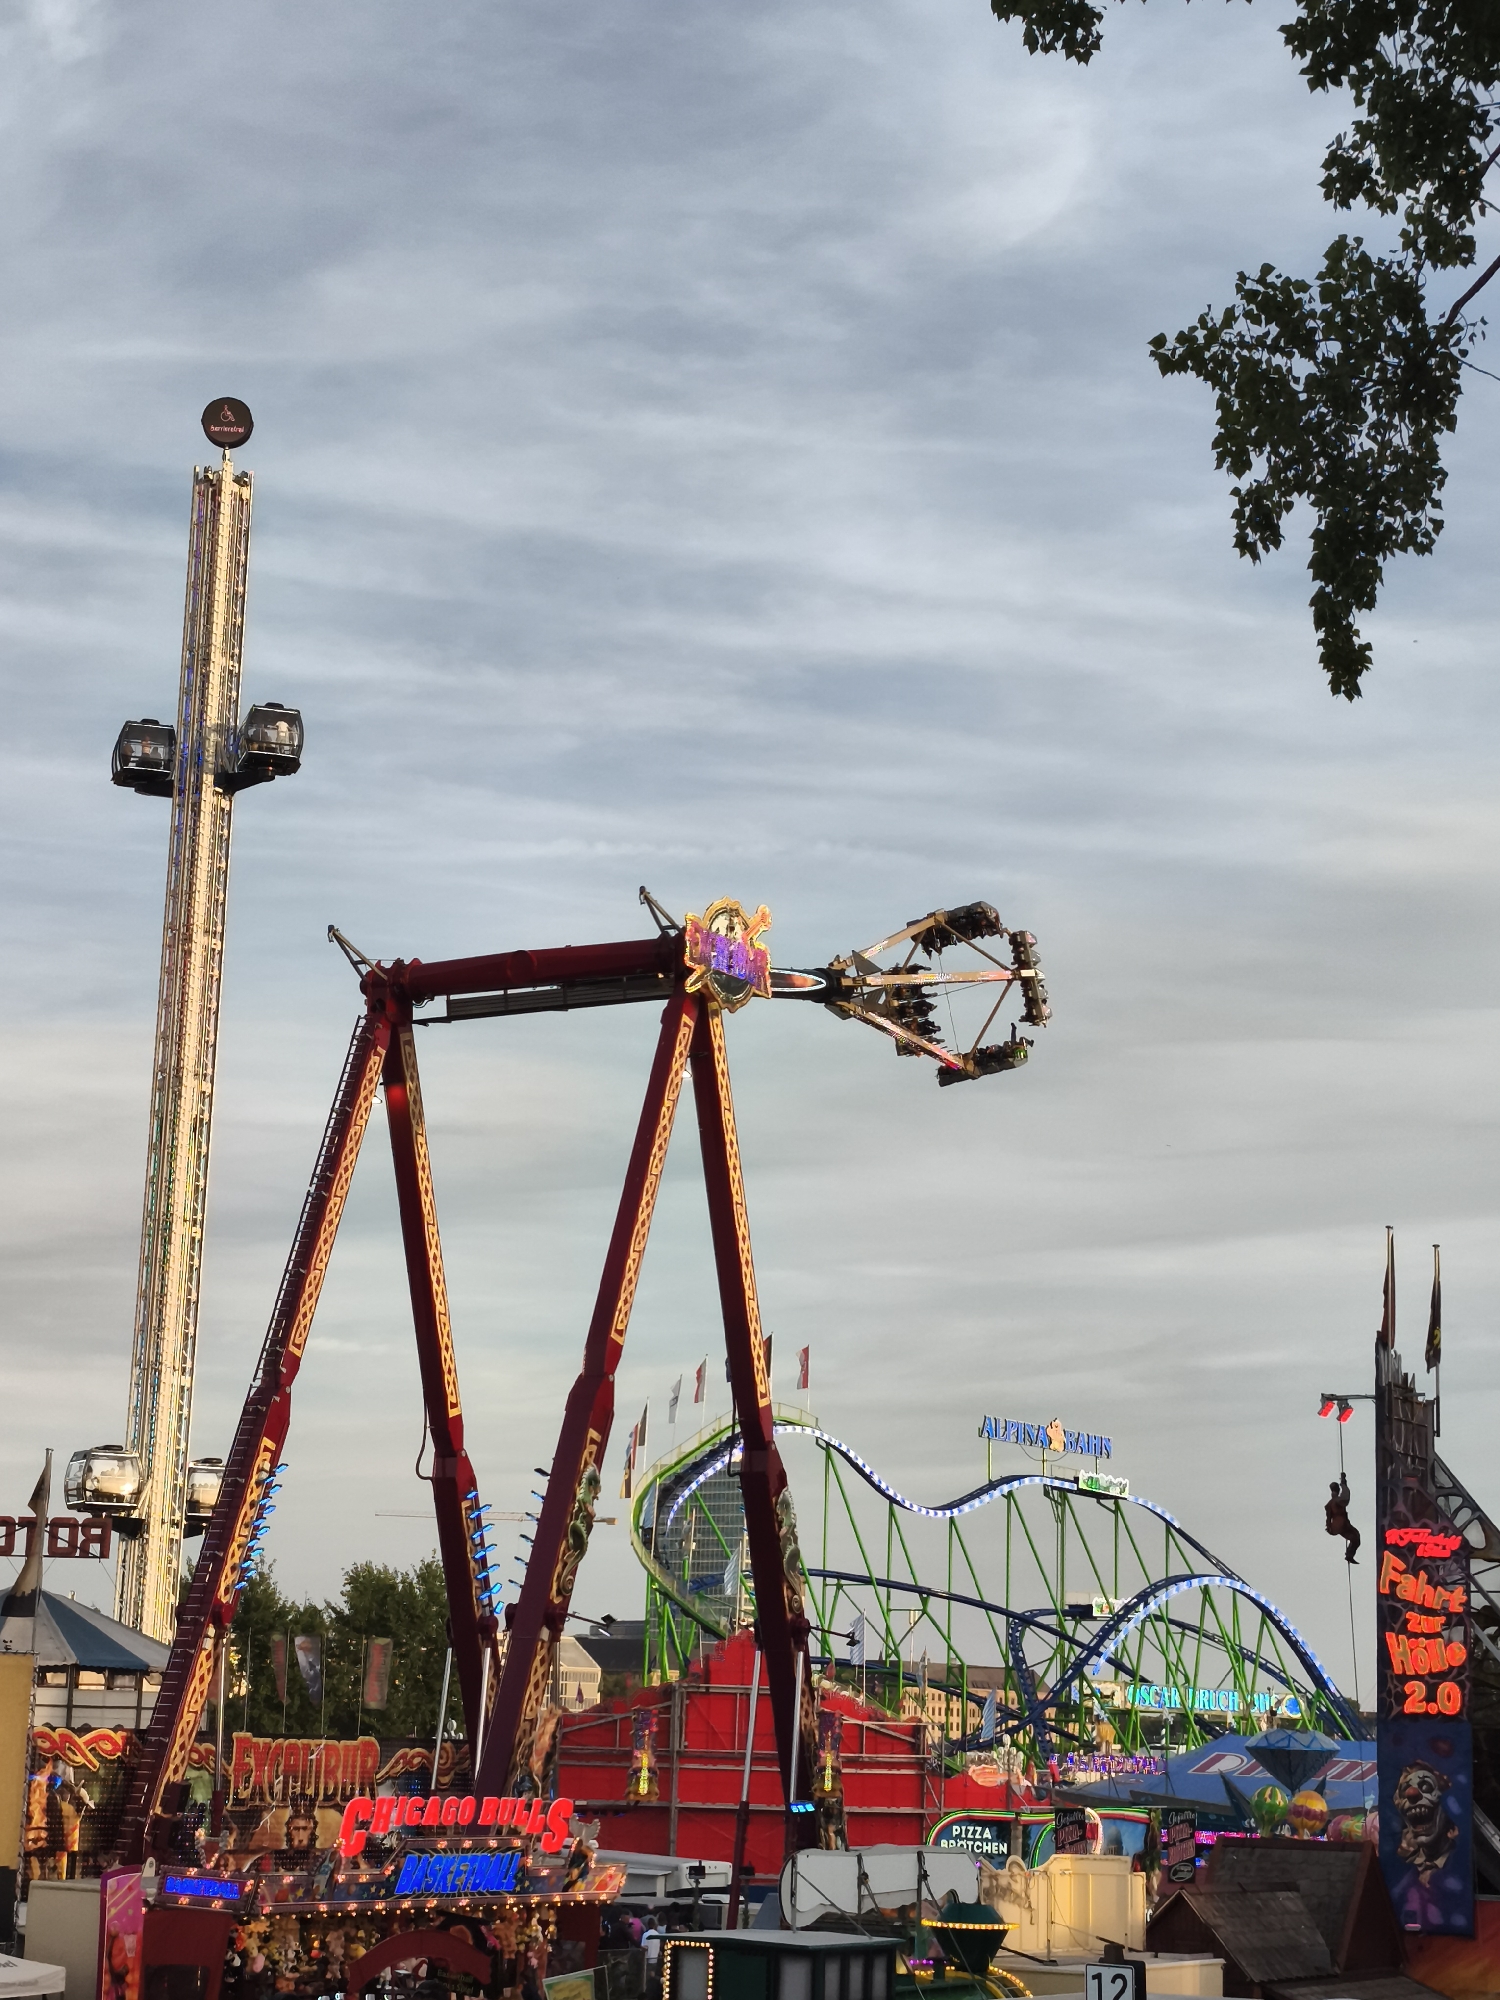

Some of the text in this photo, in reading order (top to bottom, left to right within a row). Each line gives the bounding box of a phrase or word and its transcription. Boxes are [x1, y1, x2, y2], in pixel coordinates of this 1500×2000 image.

[980, 1415, 1113, 1459] ALPINA BAHN
[1379, 1550, 1467, 1613] Fahrt
[1405, 1612, 1446, 1634] zur
[1385, 1632, 1467, 1675] Hölle
[1125, 1684, 1181, 1708] OSCAR
[1187, 1687, 1239, 1712] BRUCH
[1404, 1680, 1461, 1715] 2.0
[227, 1733, 380, 1810] EXCALIBUR
[339, 1796, 574, 1857] CHICAGO BULLS
[952, 1825, 992, 1840] PIZZA
[940, 1839, 1008, 1855] BRÖTCHEN
[394, 1852, 521, 1895] BASKETBALL
[1091, 1972, 1128, 2000] 12
